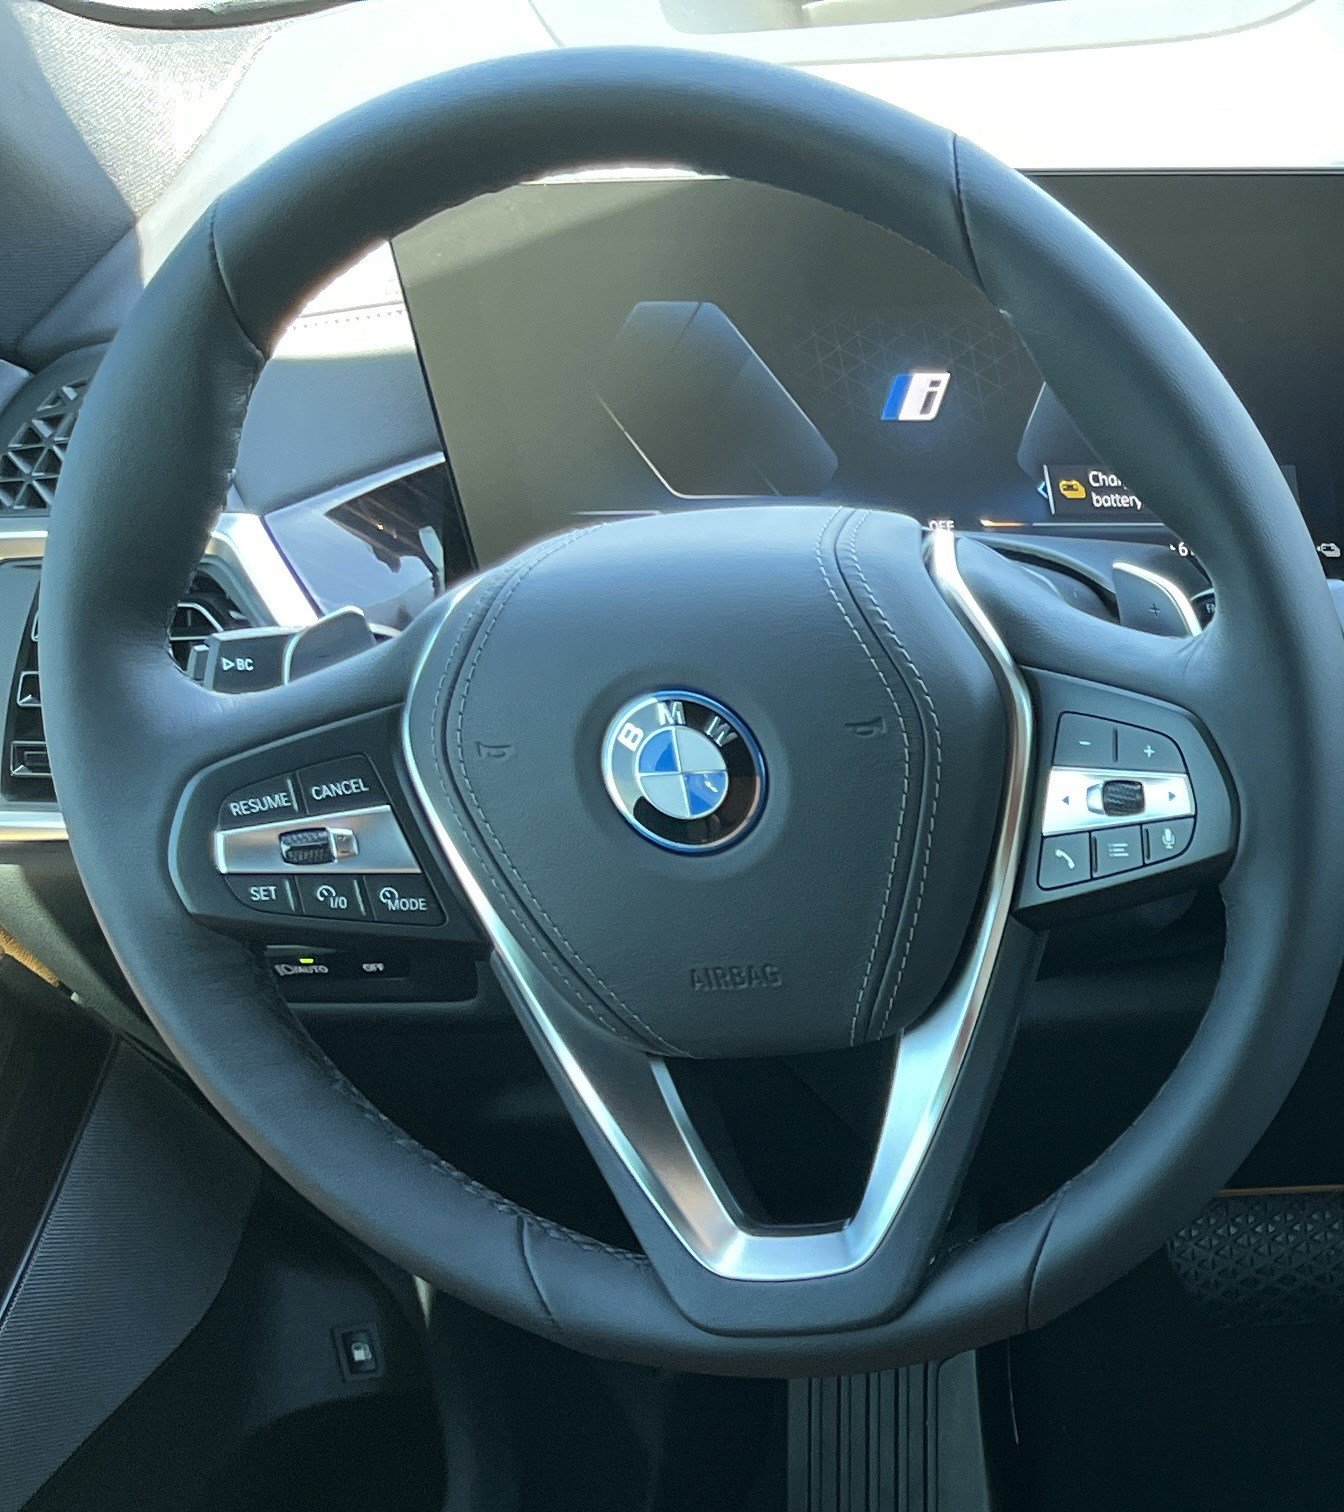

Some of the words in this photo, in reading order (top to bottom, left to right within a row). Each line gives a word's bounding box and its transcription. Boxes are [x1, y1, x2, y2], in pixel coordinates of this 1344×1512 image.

[235, 658, 254, 671] BC
[616, 700, 738, 752] BMW
[311, 778, 369, 800] CANCEL
[229, 792, 292, 816] RESUME
[250, 886, 276, 901] SET
[387, 898, 427, 911] MODE
[690, 963, 783, 991] AIRBAG
